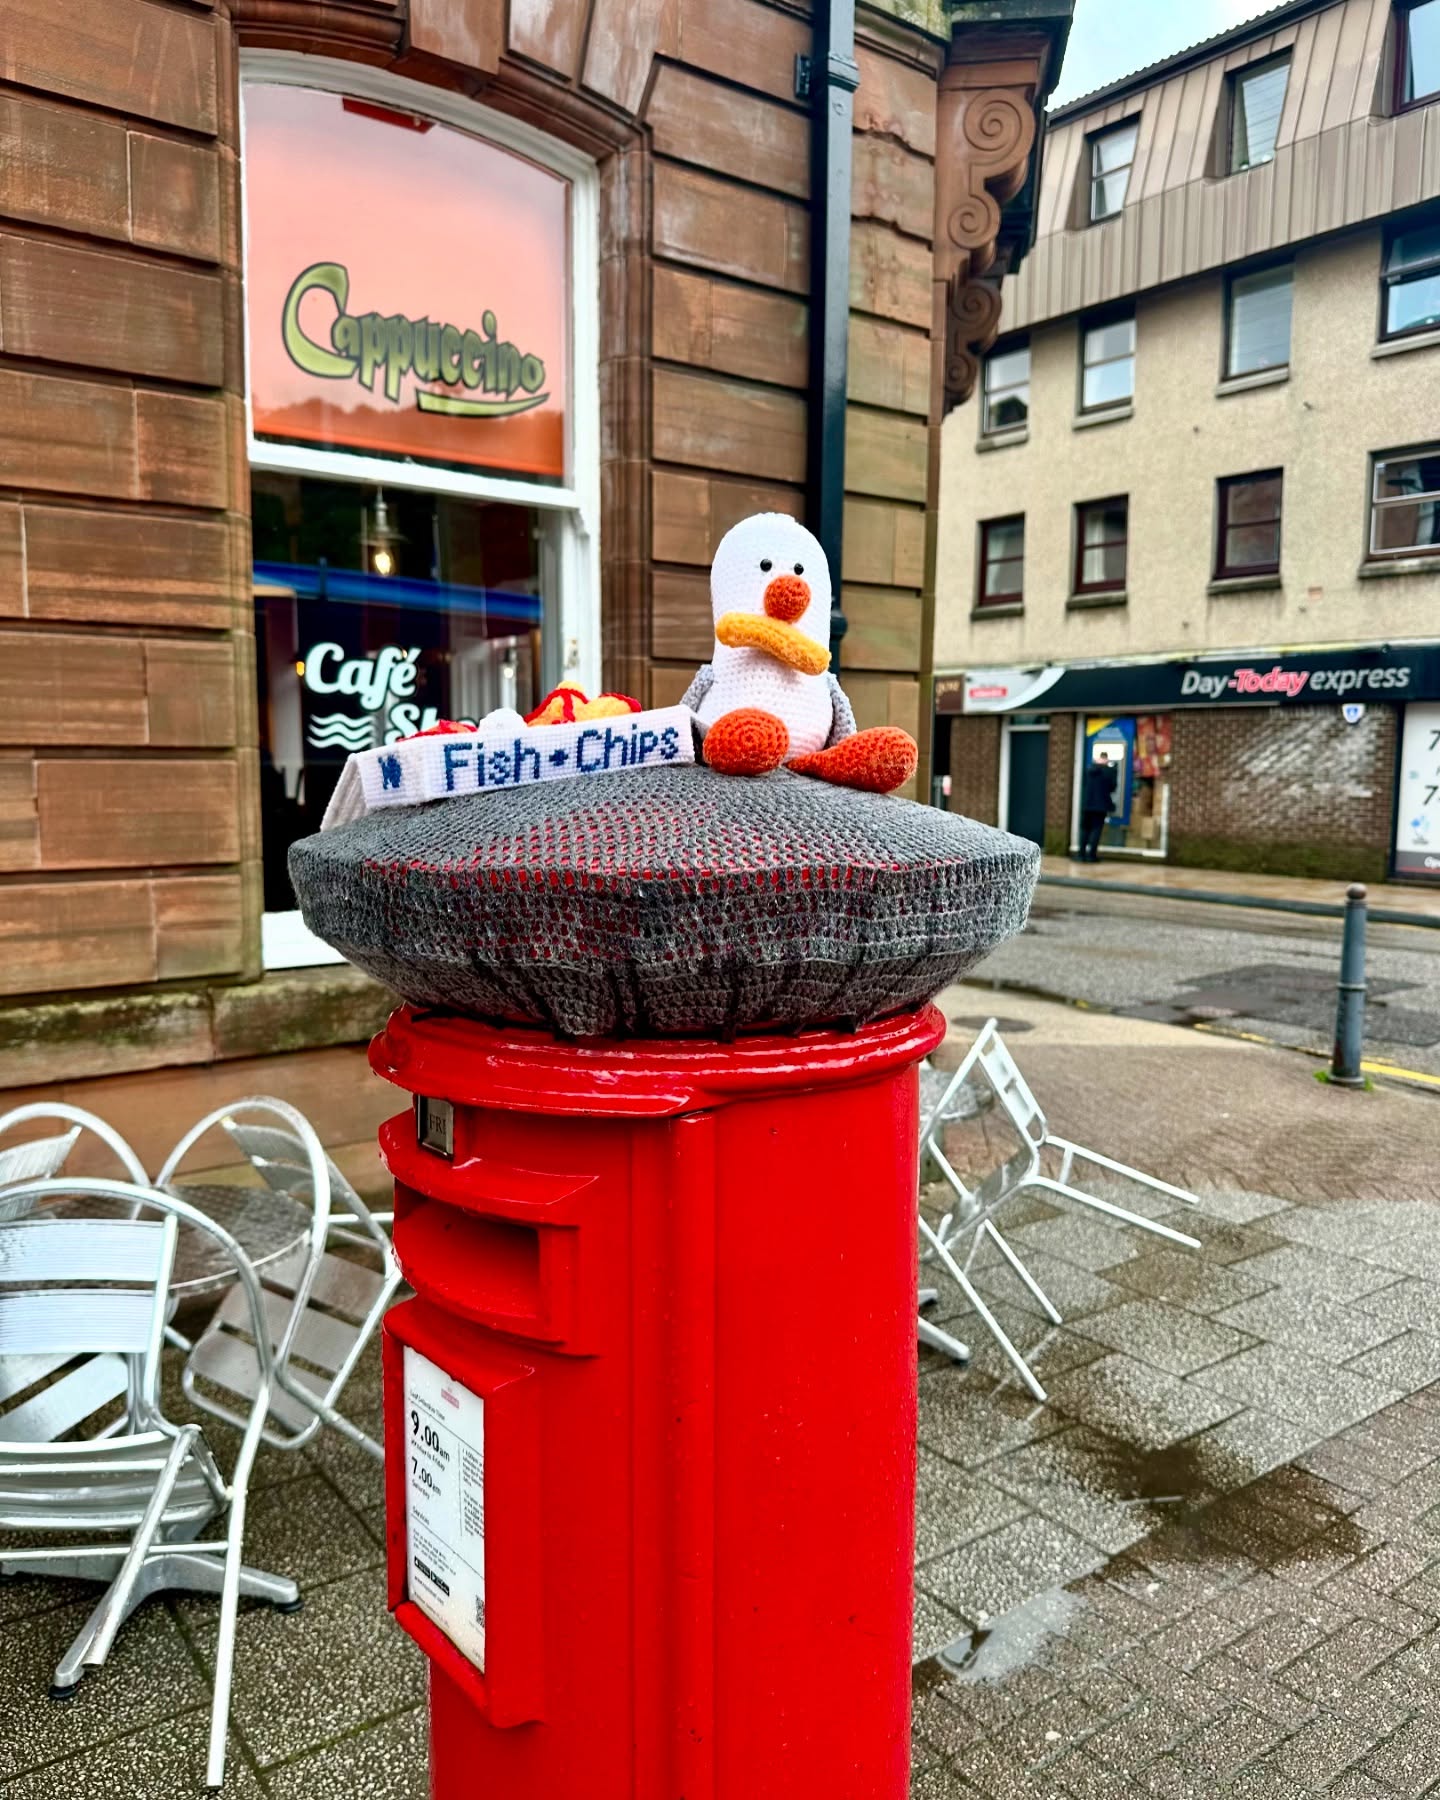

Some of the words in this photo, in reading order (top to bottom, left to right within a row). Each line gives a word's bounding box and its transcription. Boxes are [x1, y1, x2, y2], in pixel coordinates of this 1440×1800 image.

[282, 262, 545, 402] Cappuccino
[304, 642, 422, 711] Café
[1181, 666, 1310, 699] Day-Today
[1309, 667, 1411, 695] express
[443, 738, 541, 792] Fish
[576, 723, 679, 773] Chips
[429, 1113, 447, 1137] FRI
